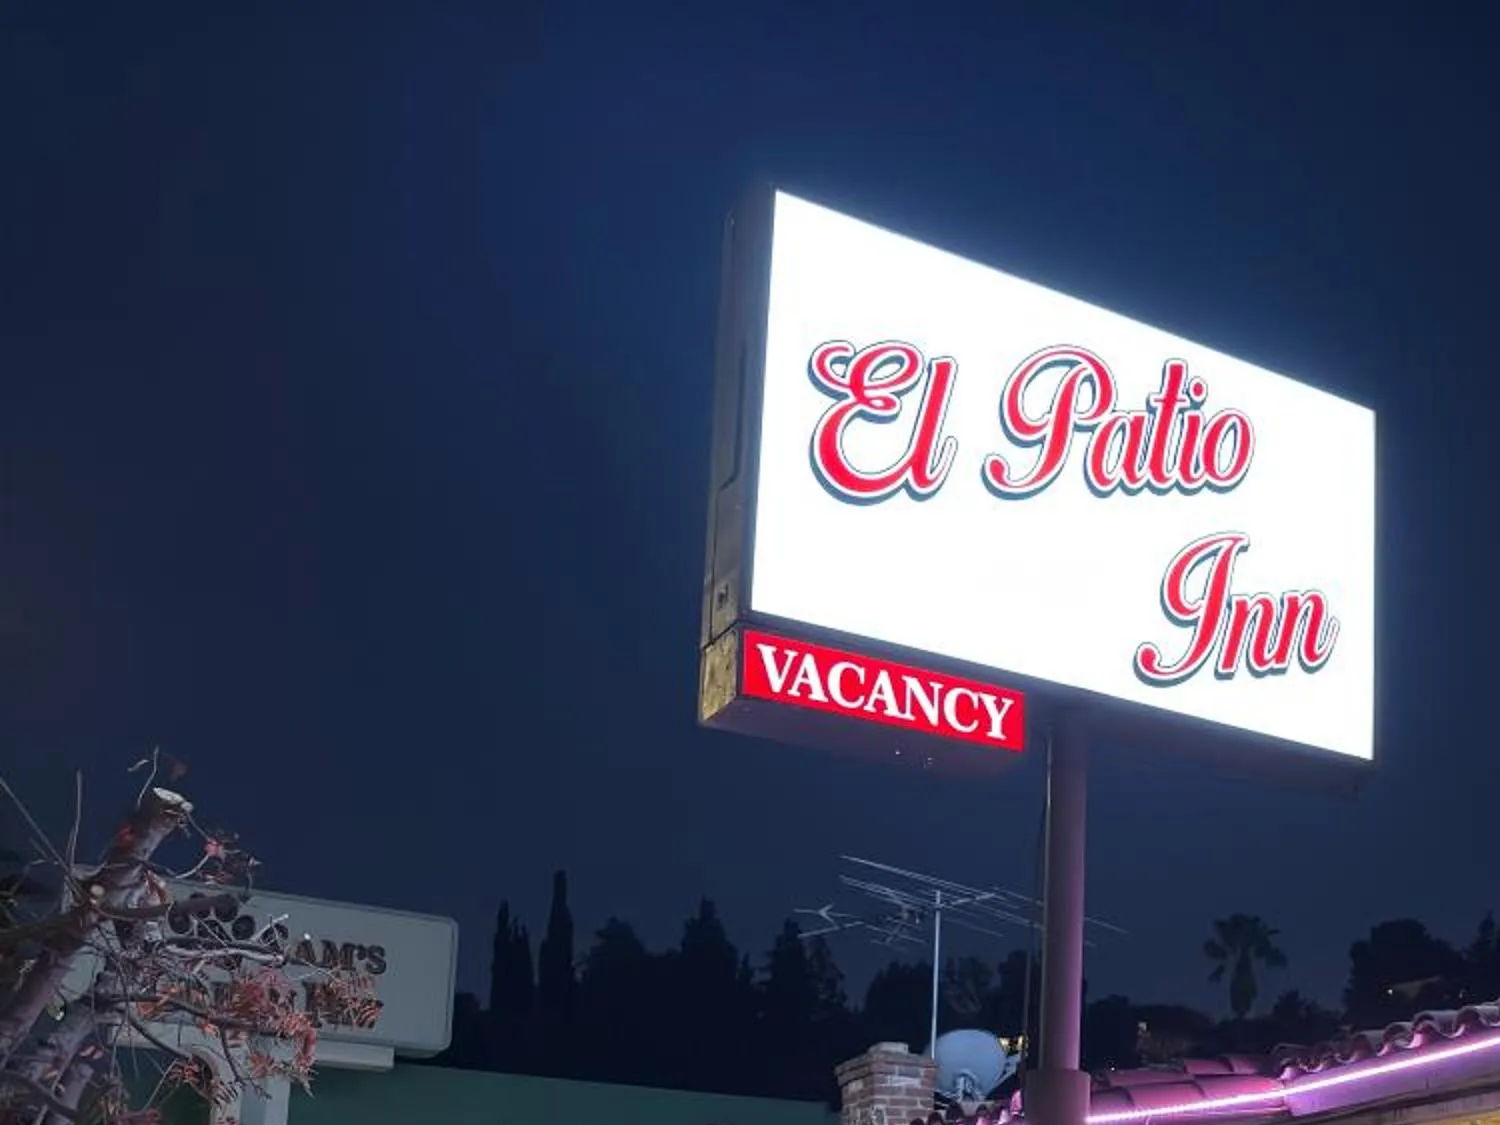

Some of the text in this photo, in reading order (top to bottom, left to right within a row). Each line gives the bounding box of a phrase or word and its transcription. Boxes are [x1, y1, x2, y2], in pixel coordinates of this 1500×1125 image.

[808, 339, 1256, 506] El Patio
[1133, 530, 1340, 689] Inn
[756, 643, 1014, 740] VACANCY
